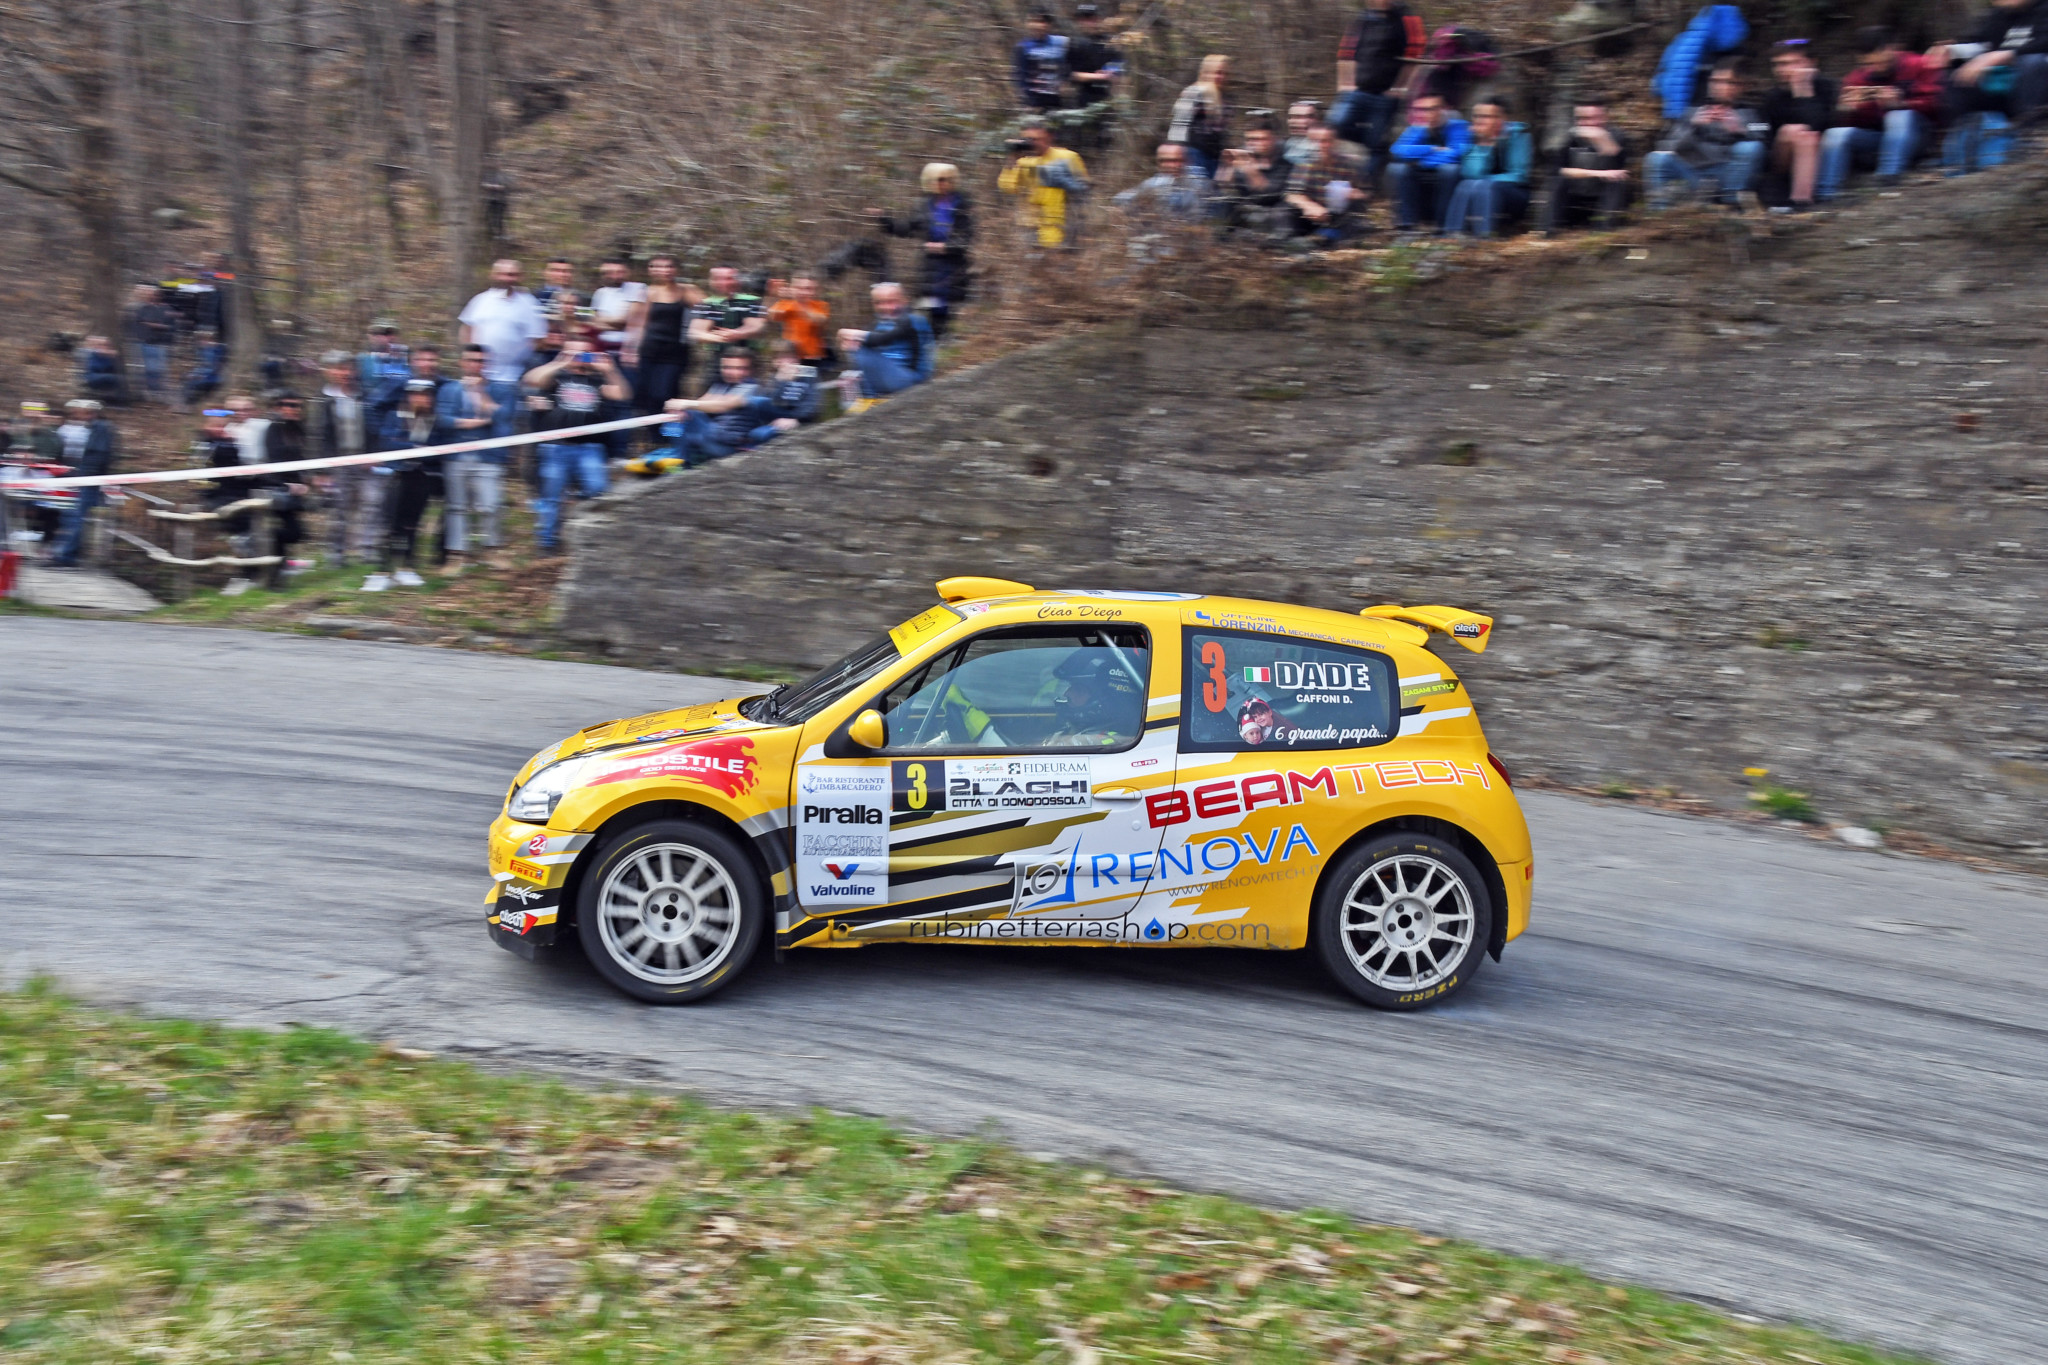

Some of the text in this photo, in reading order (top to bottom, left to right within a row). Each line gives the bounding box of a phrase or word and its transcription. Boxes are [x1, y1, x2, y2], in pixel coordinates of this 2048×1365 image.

[1037, 605, 1122, 621] Ciao Diego
[1212, 618, 1287, 634] LORENZINA
[1288, 628, 1386, 650] MECHANICAL CARPENTRY
[1201, 641, 1228, 713] 3
[1274, 661, 1371, 691] DADE
[1432, 683, 1455, 692] STYLE
[1296, 694, 1353, 704] CAFFONI D.
[1288, 723, 1338, 746] grande
[1024, 763, 1088, 773] FIDEURAM
[819, 783, 882, 791] IMBARCADERO
[906, 763, 928, 809] 3
[988, 798, 998, 806] DI
[1002, 796, 1087, 807] DOMODOSSOLA
[804, 805, 883, 824] Piralla
[530, 836, 547, 853] 24
[1091, 822, 1320, 888] RENOVA
[811, 884, 875, 896] Valvoline
